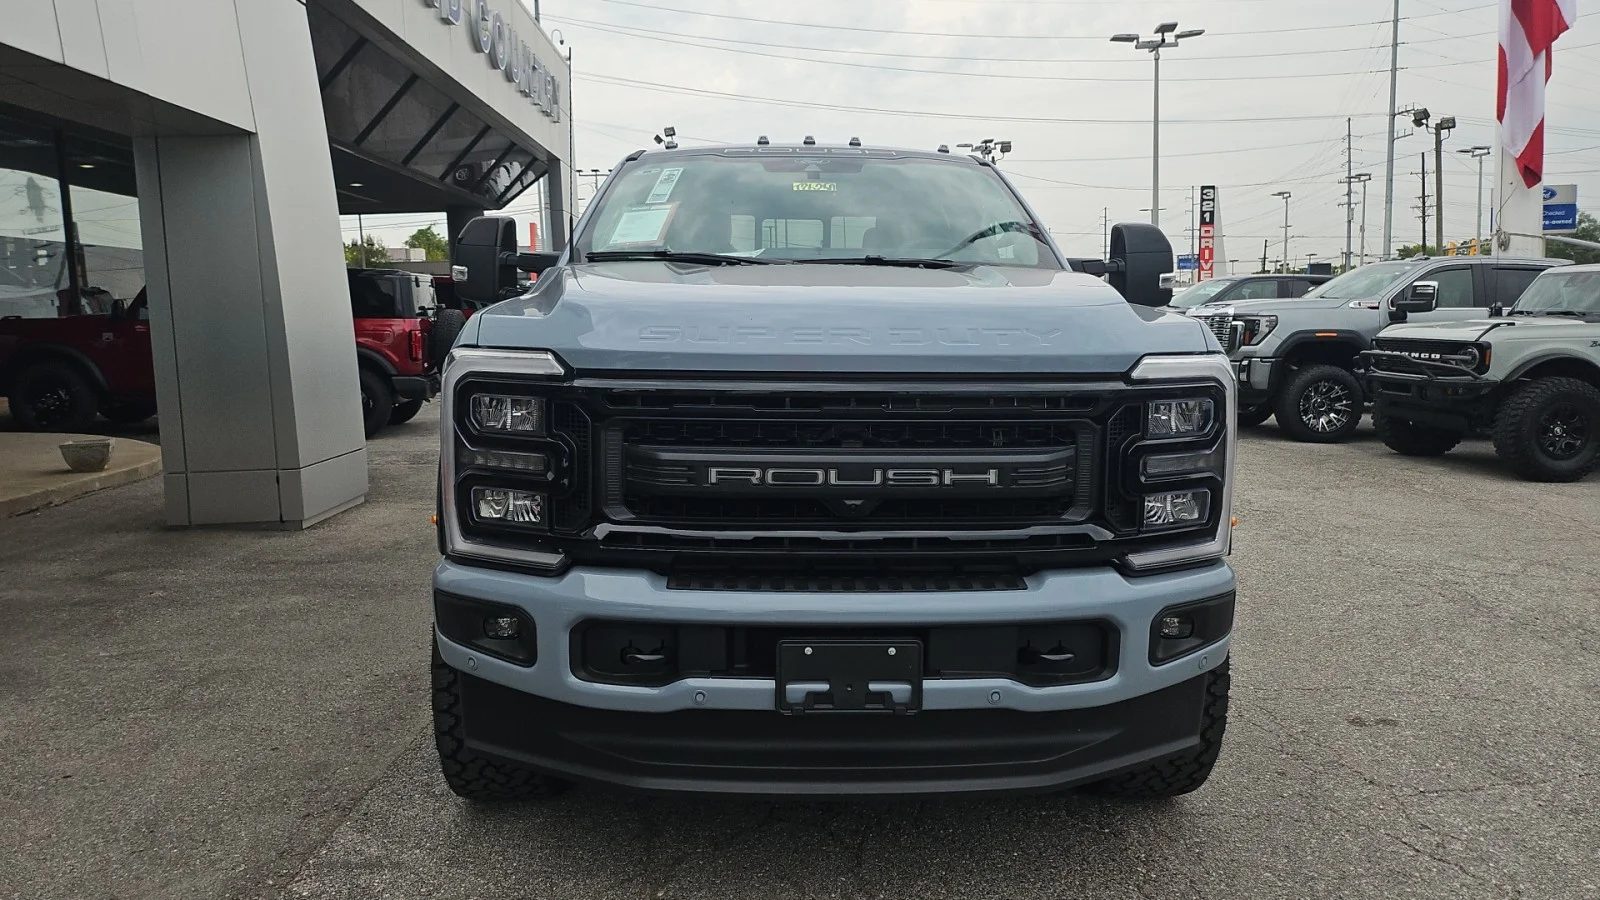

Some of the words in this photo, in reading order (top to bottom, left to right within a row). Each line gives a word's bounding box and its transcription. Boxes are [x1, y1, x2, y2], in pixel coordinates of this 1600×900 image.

[470, 0, 560, 123] COUNTRY
[1202, 188, 1214, 223] 321
[1200, 226, 1213, 281] DRIVE
[639, 326, 872, 345] SUPER
[888, 327, 1063, 346] DUTY
[708, 467, 999, 486] ROUSH
